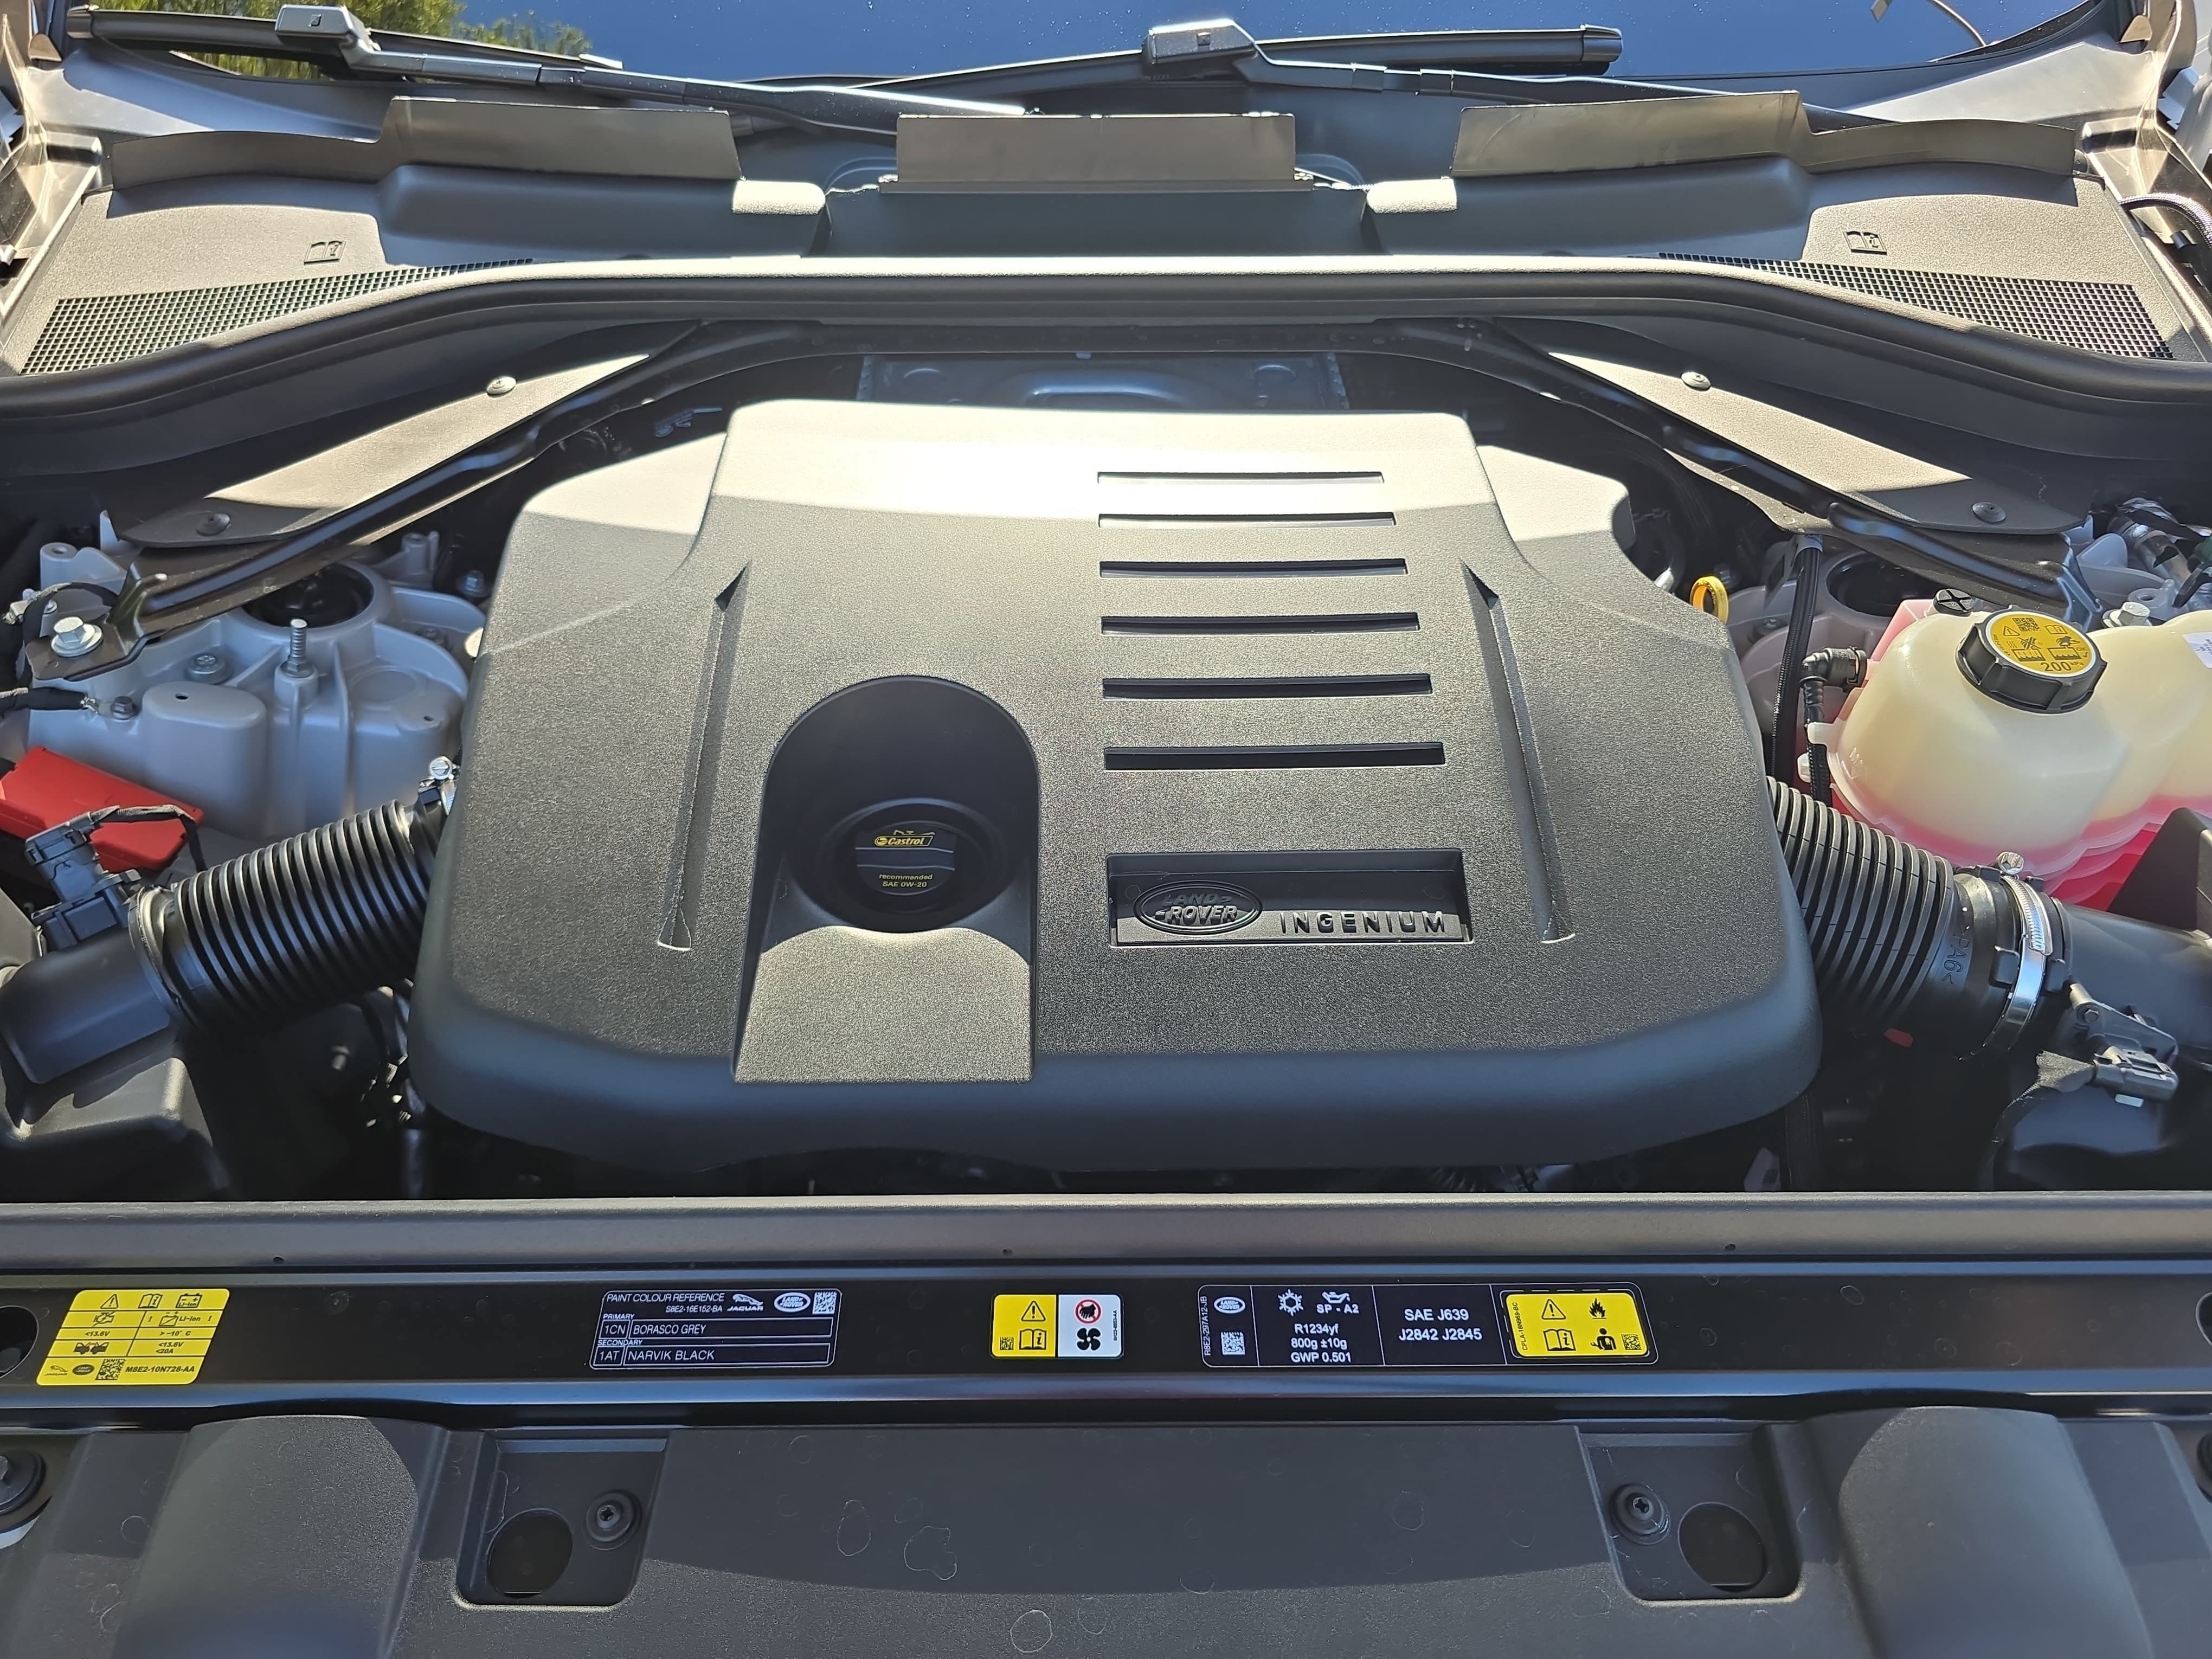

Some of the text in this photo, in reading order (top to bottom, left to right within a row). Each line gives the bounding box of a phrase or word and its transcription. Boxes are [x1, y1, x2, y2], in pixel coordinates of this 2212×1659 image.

[2041, 661, 2072, 671] 200
[888, 837, 925, 845] Castrol
[1162, 893, 1219, 905] LAND
[1167, 905, 1237, 922] ROVER
[1280, 911, 1446, 934] INGENIUM
[607, 1293, 725, 1302] PAINT COLOUR REFERENCE
[1316, 1304, 1332, 1314] SP
[1344, 1304, 1359, 1314] A2
[1404, 1308, 1469, 1321] SAE J639
[605, 1324, 626, 1334] 1CN
[633, 1324, 707, 1334] BORASCO GREY
[1294, 1323, 1339, 1334] R1234yf
[1512, 1301, 1528, 1351] CPLA-18N969-BC
[1399, 1328, 1482, 1341] J2842 J2845
[1291, 1338, 1347, 1350] 800g ±10g
[600, 1351, 620, 1360] 1AT
[628, 1350, 715, 1360] NARVIK BLACK
[1291, 1352, 1352, 1363] GWP 0.501
